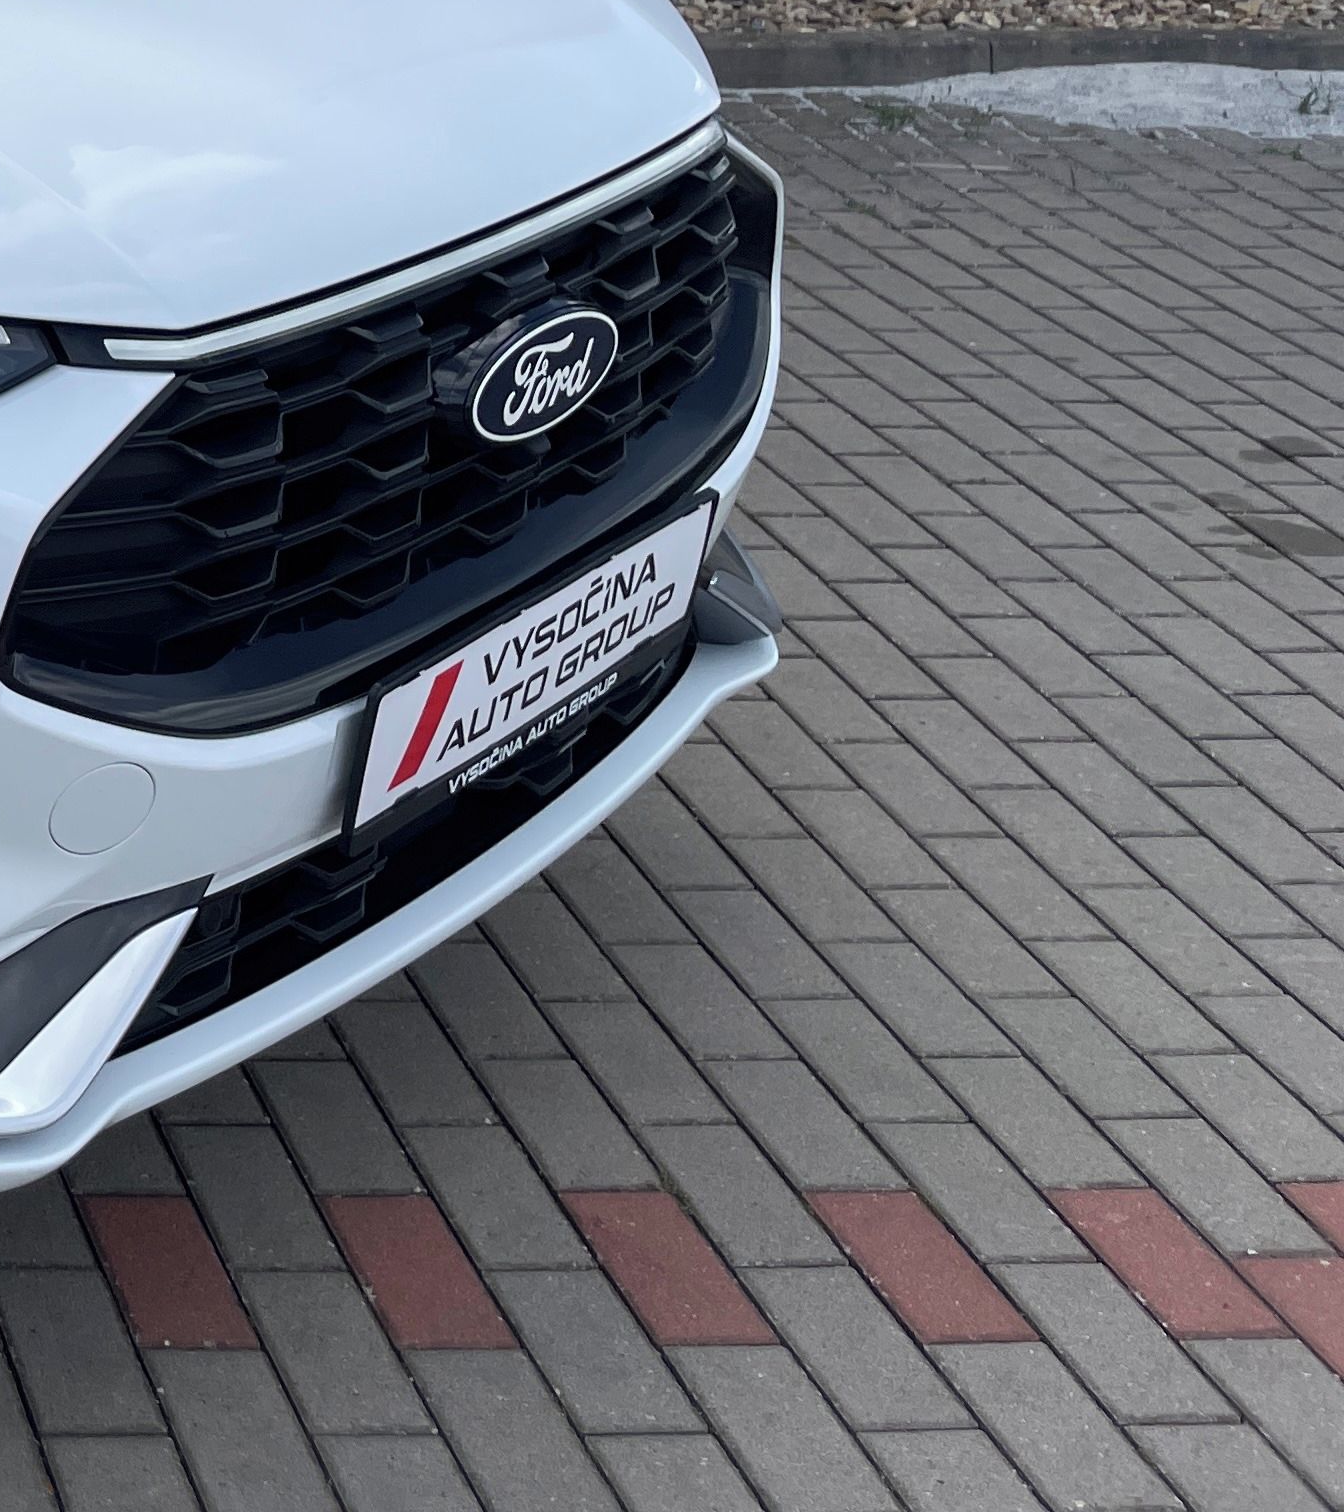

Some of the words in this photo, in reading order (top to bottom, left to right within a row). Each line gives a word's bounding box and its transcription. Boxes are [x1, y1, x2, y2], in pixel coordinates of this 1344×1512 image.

[502, 331, 595, 427] Ford
[435, 665, 550, 763] AUTO
[555, 582, 676, 688] GROUP
[483, 552, 657, 686] VYSOČINA
[525, 705, 568, 745] AUTO
[568, 671, 619, 717] GROUP
